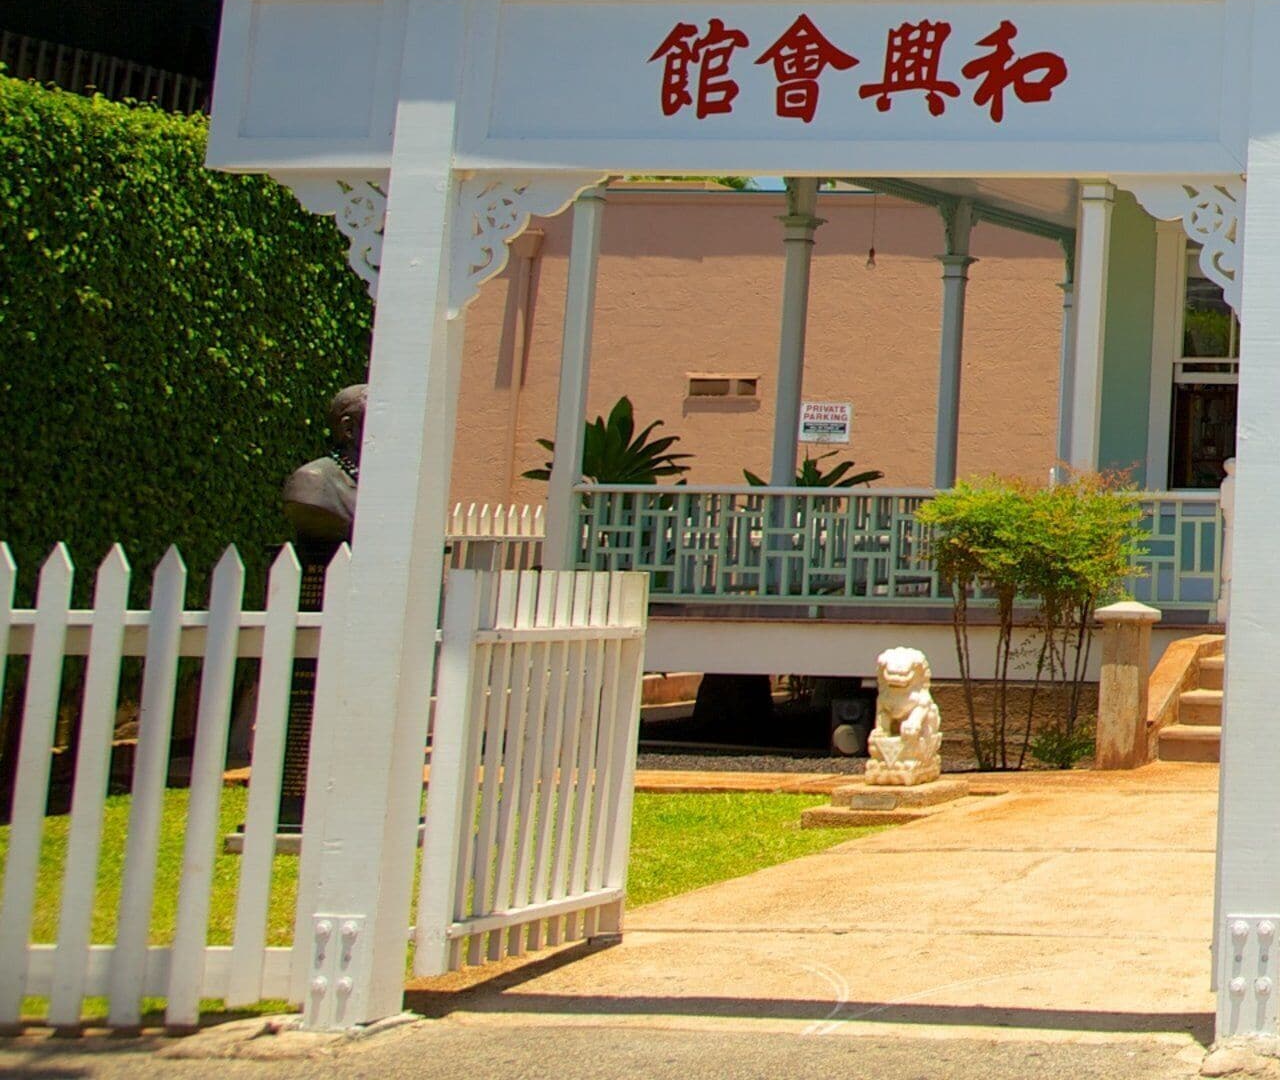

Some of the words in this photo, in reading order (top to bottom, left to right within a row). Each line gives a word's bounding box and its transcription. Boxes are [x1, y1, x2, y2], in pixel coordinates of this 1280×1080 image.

[648, 13, 1068, 123] 和興會館
[806, 405, 846, 413] PRIVATE
[803, 413, 847, 421] PARKING
